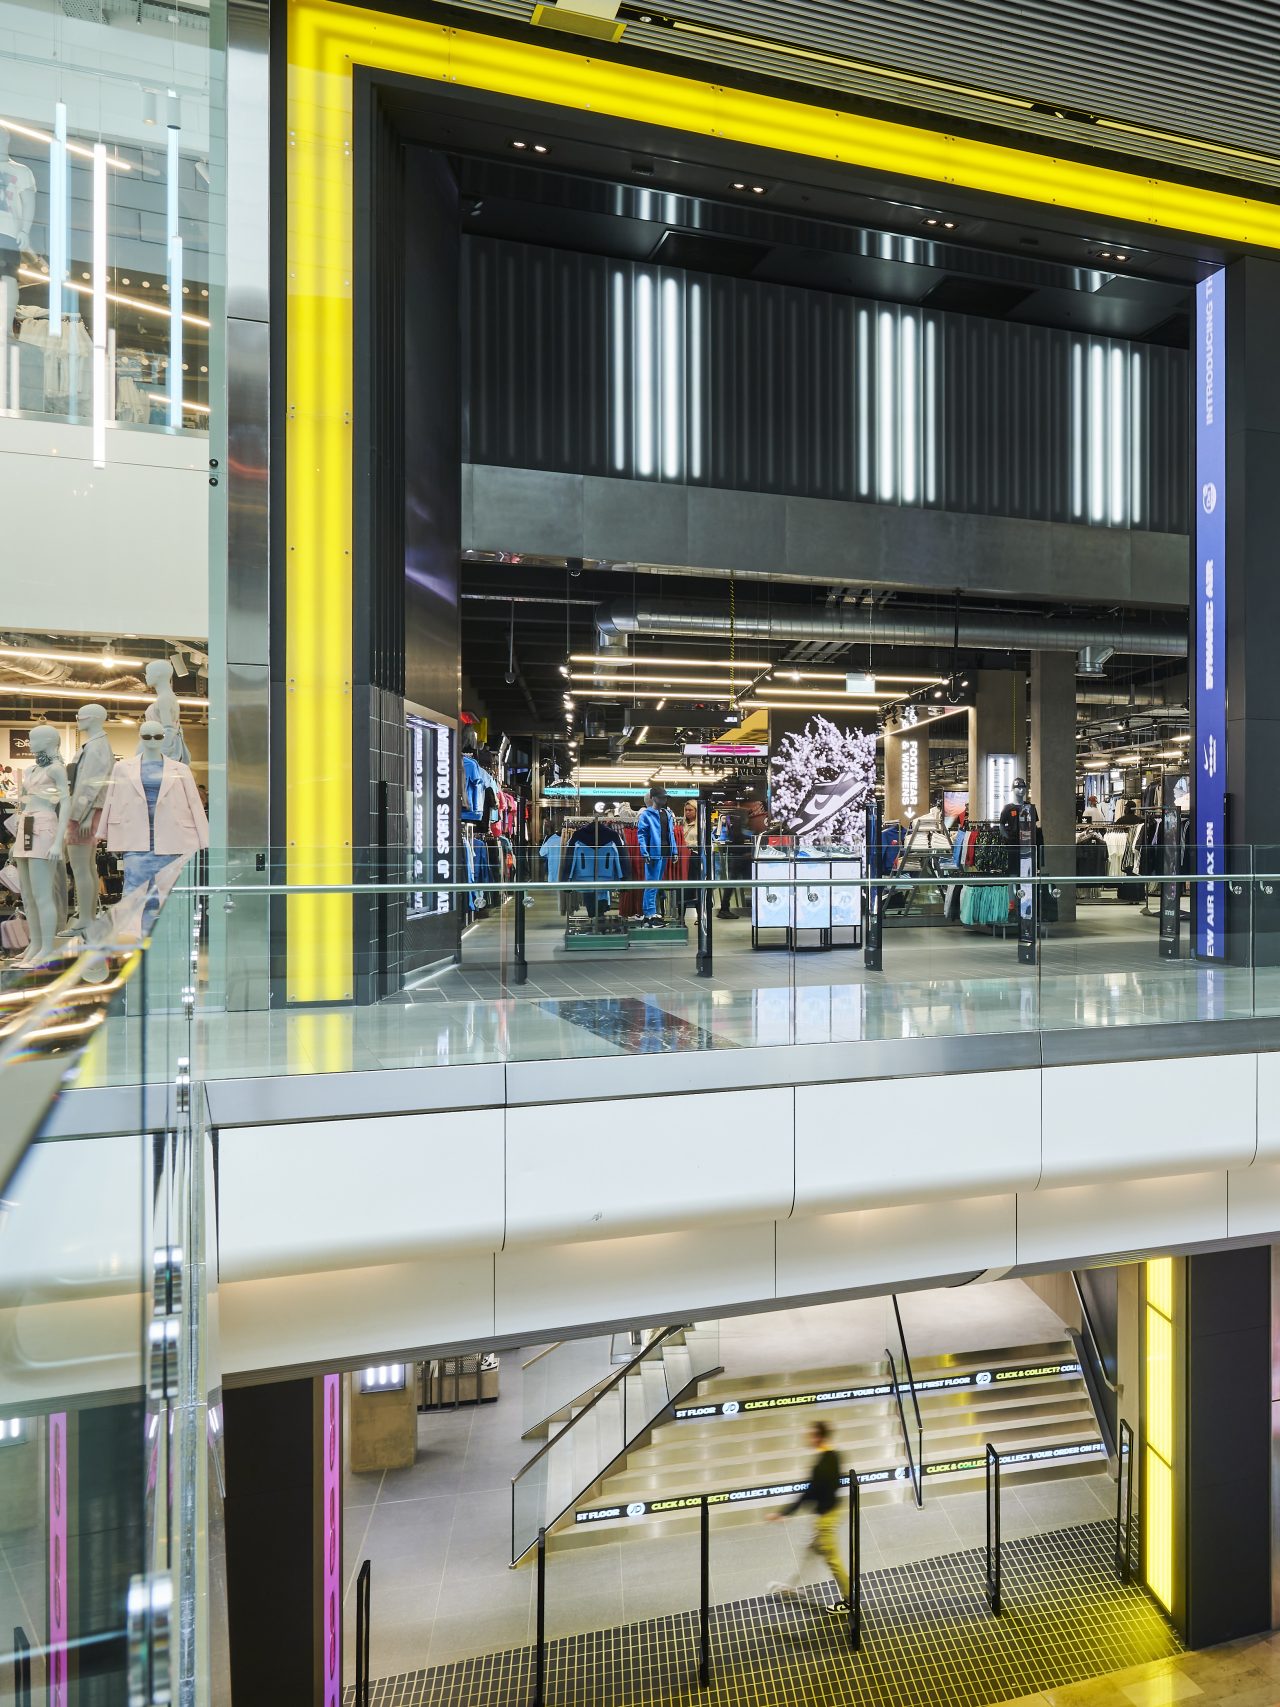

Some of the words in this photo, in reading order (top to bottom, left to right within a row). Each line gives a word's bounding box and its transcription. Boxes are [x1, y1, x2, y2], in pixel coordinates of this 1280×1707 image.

[1206, 303, 1214, 425] INTRODUCING
[902, 741, 910, 750] &
[902, 753, 910, 805] WOMENS
[909, 741, 918, 805] FOOTWEAR
[437, 804, 450, 855] SPORTS
[1206, 822, 1214, 848] DN
[1206, 896, 1214, 927] AIR
[687, 1406, 717, 1416] FLOOR
[744, 1400, 769, 1410] CLICK
[769, 1399, 775, 1407] &
[776, 1395, 817, 1406] COLLECT?
[816, 1391, 851, 1401] COLLECT
[851, 1388, 874, 1397] YOUR
[944, 1377, 971, 1386] FLOOR
[996, 1372, 1018, 1380] CLICK
[1025, 1366, 1060, 1376] COLLECT?
[926, 1464, 950, 1474] CLICK
[998, 1452, 1030, 1464] COLLECT
[1030, 1450, 1053, 1460] YOUR
[1053, 1447, 1079, 1457] ORDER
[1080, 1445, 1092, 1453] ON
[861, 1472, 889, 1483] FLOOR
[588, 1508, 620, 1519] FLOOR
[651, 1501, 677, 1511] CLICK
[678, 1499, 685, 1507] &
[686, 1493, 730, 1506] COLECT?
[729, 1488, 767, 1500] COLLECT
[767, 1485, 795, 1495] YOUR
